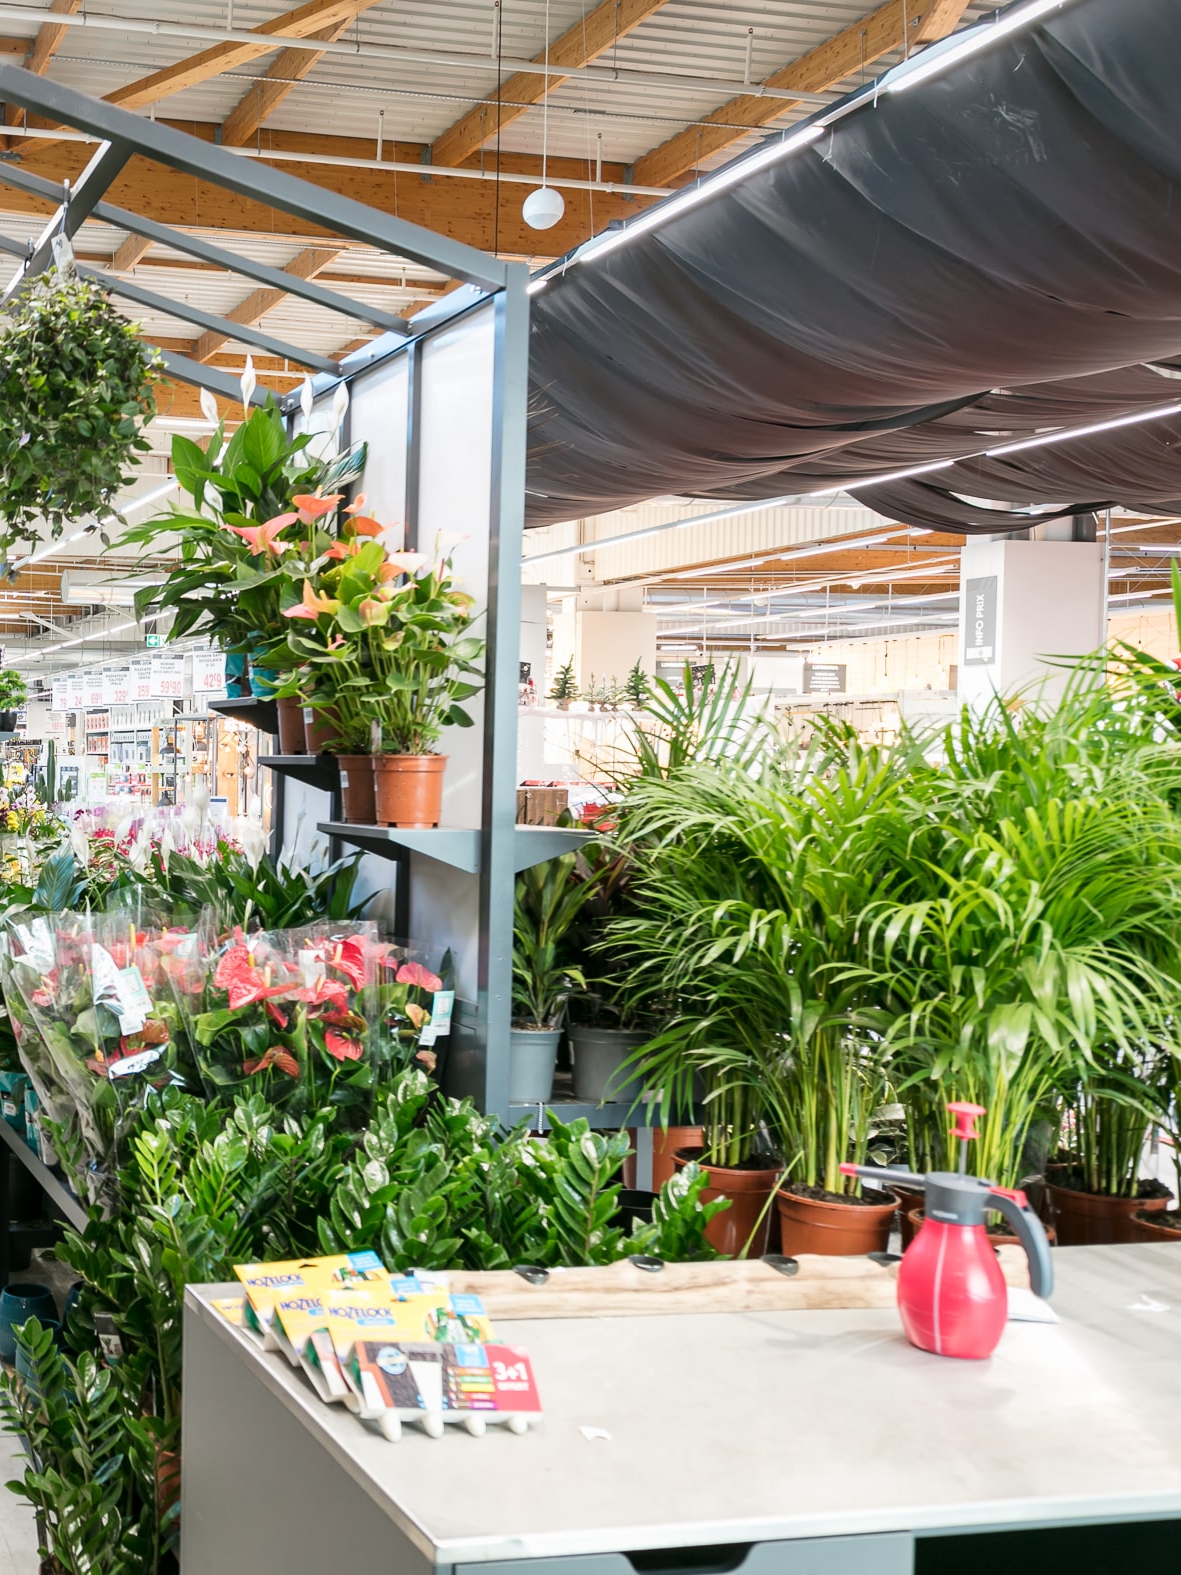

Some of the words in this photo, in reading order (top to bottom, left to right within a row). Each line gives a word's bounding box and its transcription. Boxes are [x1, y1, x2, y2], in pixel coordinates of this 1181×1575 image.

[976, 594, 985, 618] PRIX
[974, 620, 984, 646] INFO
[246, 1274, 303, 1288] HOZELOCK
[329, 1306, 393, 1320] HOZELOCK
[492, 1361, 528, 1381] 3+1
